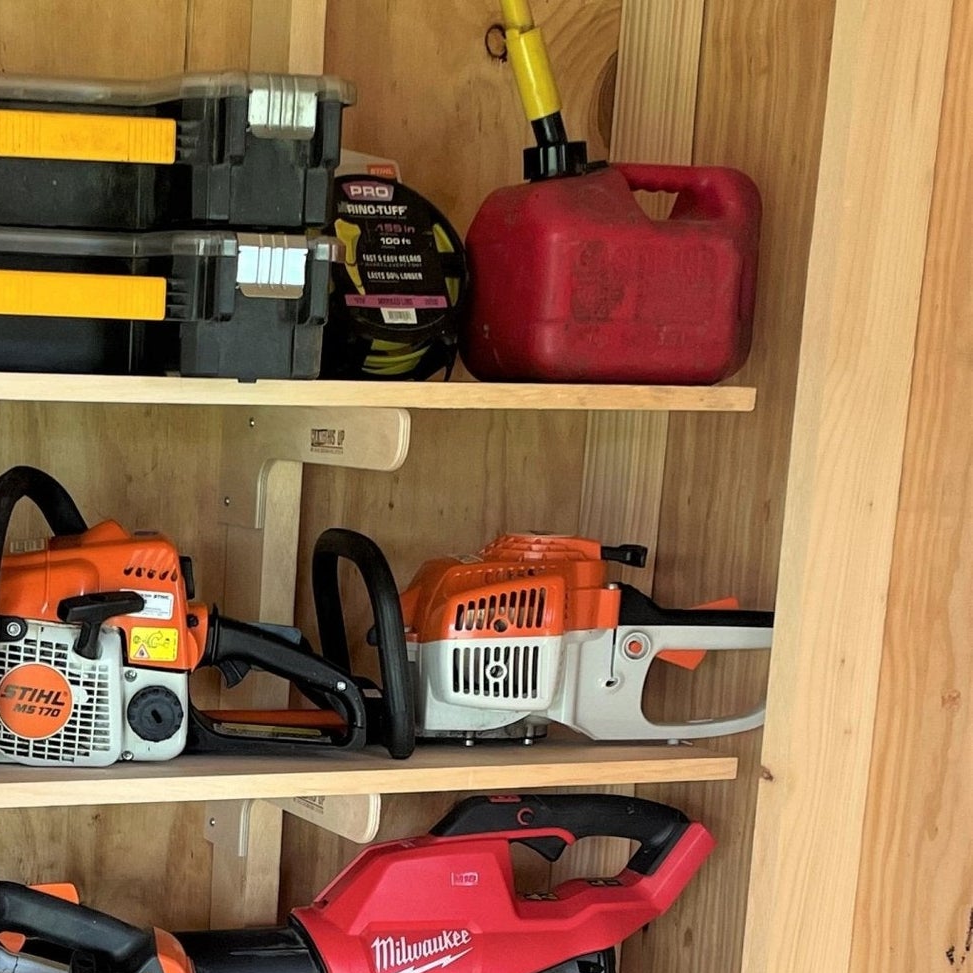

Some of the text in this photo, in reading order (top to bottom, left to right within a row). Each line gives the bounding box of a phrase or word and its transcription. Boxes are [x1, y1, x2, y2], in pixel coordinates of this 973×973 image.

[349, 185, 389, 198] PRO
[380, 237, 401, 245] 100
[1, 684, 66, 706] STIHL
[13, 703, 62, 718] MS 170
[371, 929, 472, 973] Milwaukee
